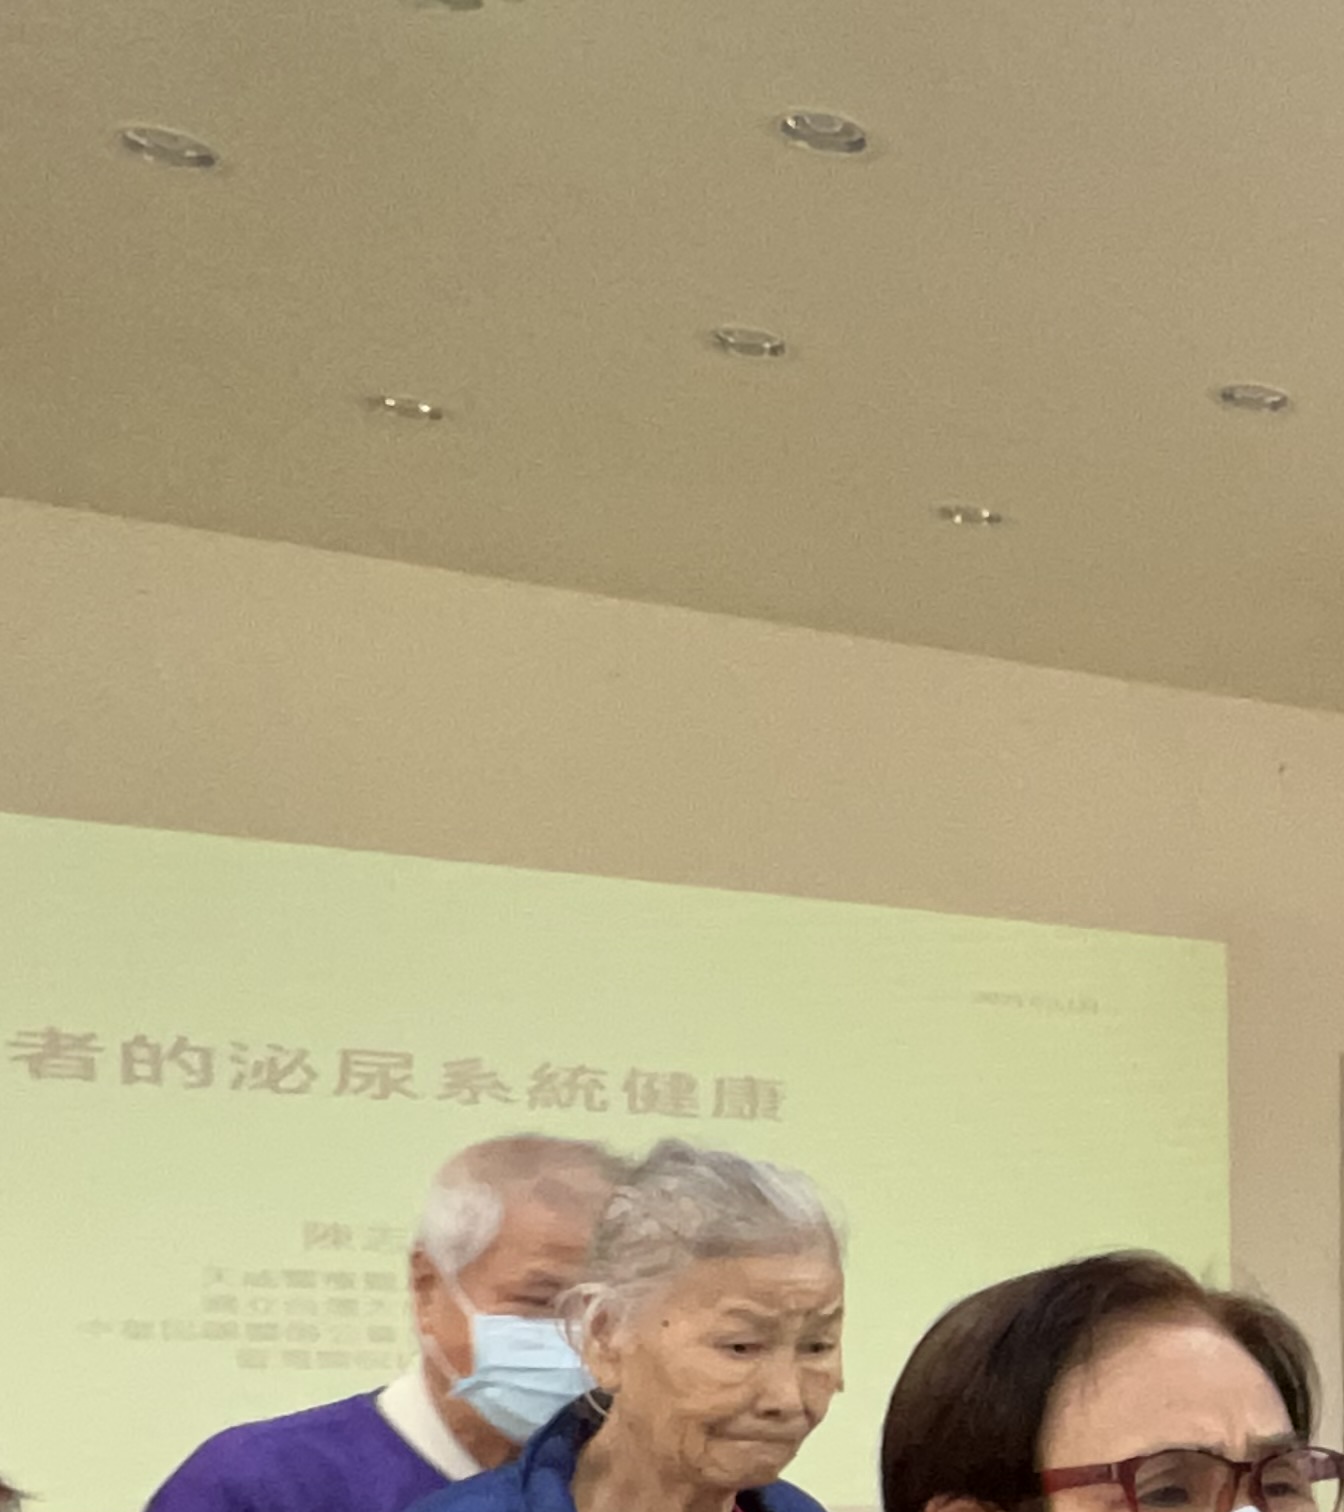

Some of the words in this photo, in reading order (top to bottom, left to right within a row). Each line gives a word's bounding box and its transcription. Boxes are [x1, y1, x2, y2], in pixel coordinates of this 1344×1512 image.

[5, 1026, 785, 1122] 者的泌尿系統健康
